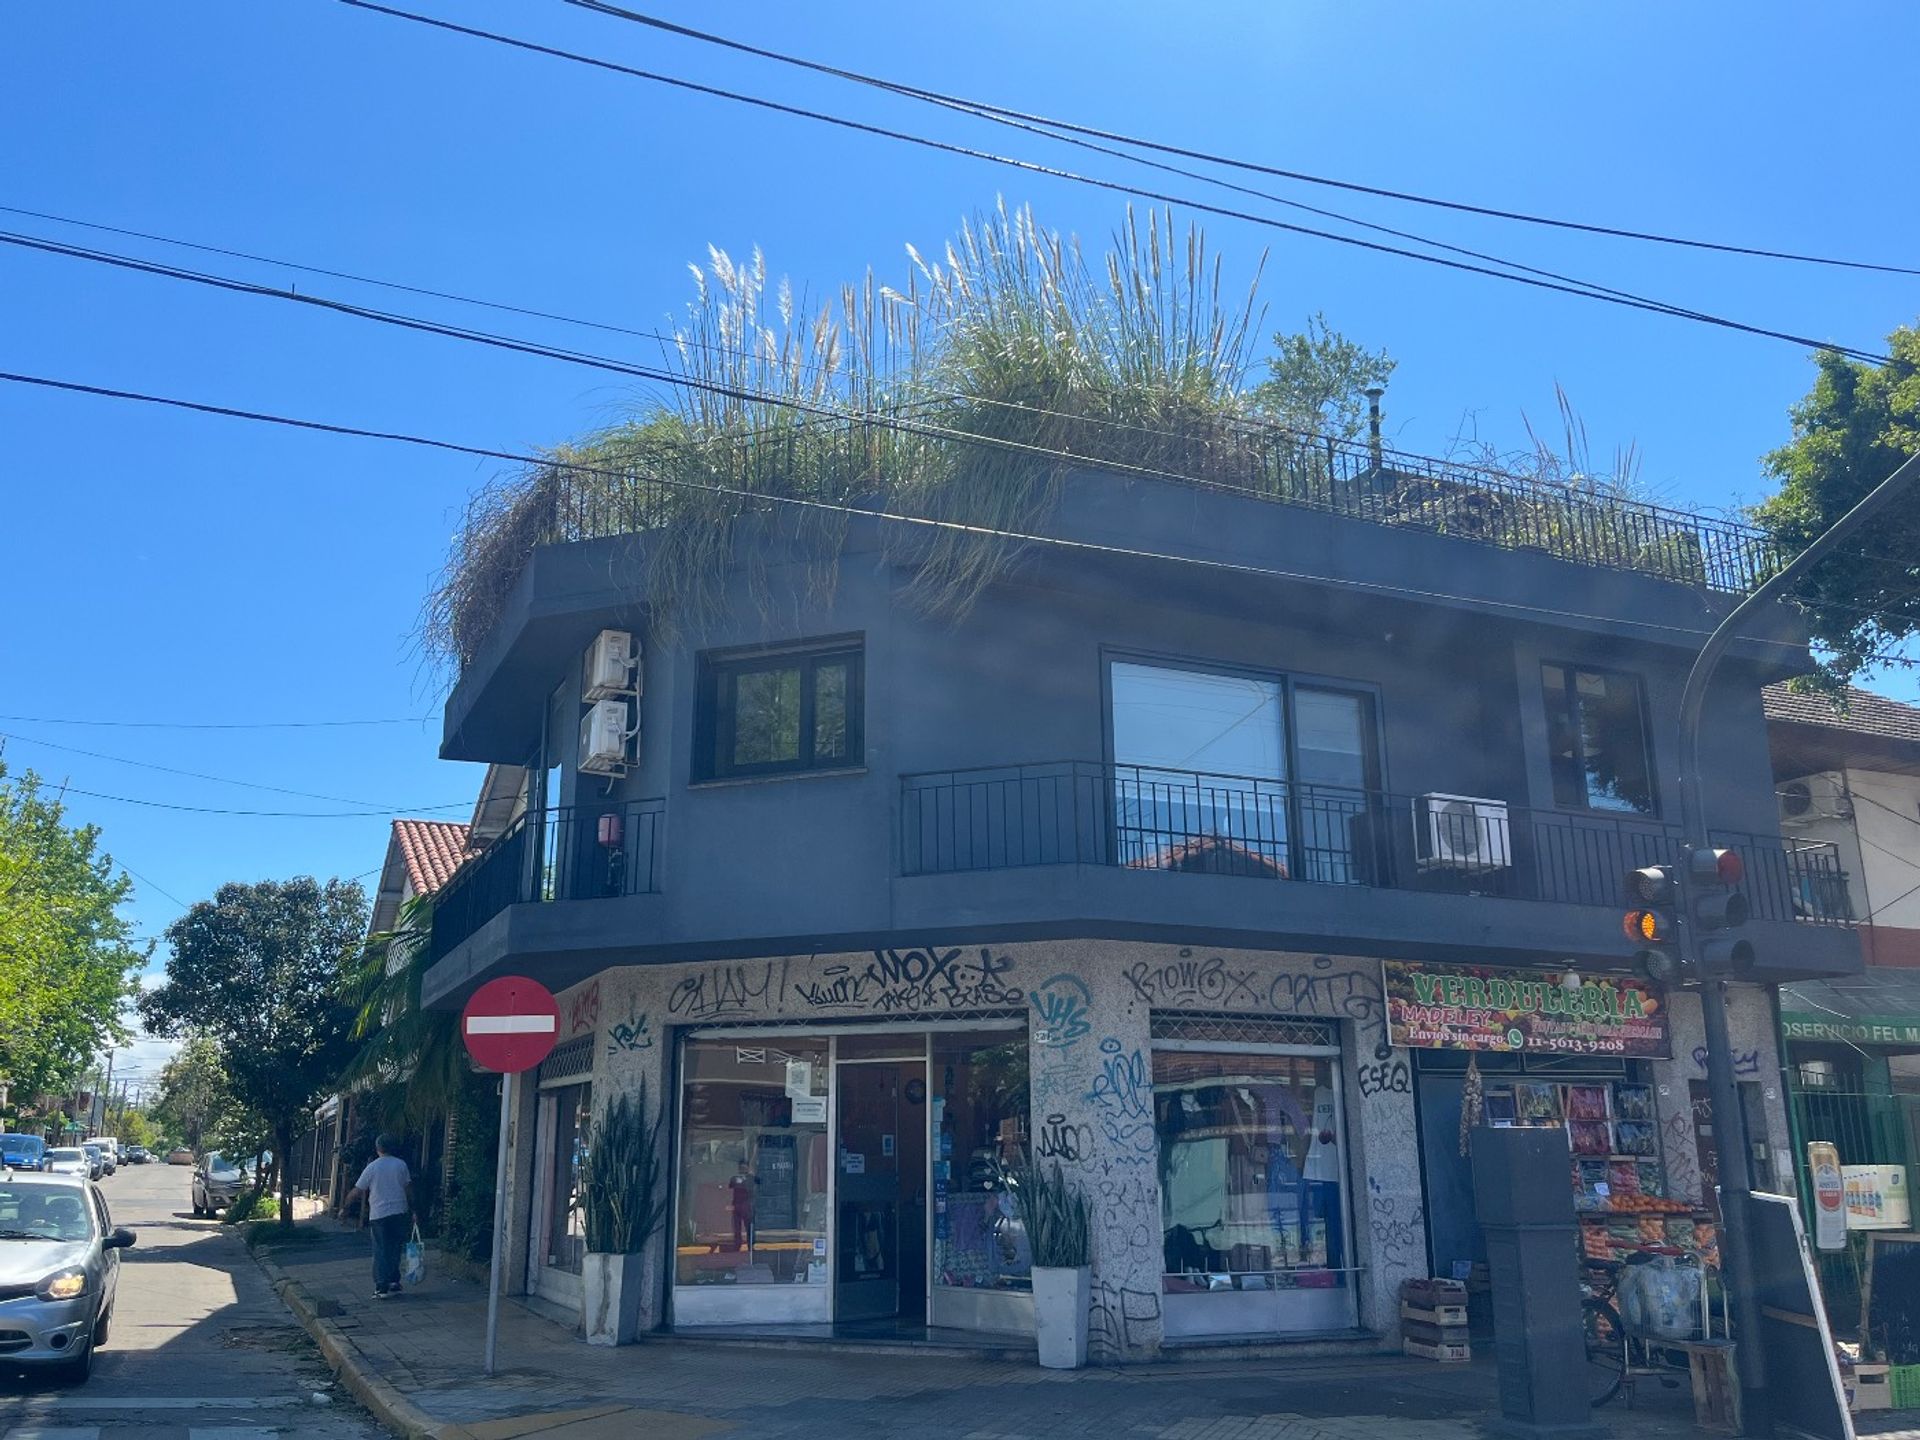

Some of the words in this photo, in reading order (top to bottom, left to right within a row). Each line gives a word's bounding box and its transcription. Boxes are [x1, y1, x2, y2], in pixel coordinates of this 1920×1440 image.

[1409, 973, 1649, 1020] VERDULERIA
[1401, 1005, 1492, 1028] MADELEY
[1451, 1028, 1470, 1042] sin
[1527, 1037, 1625, 1052] 11-5613-9208
